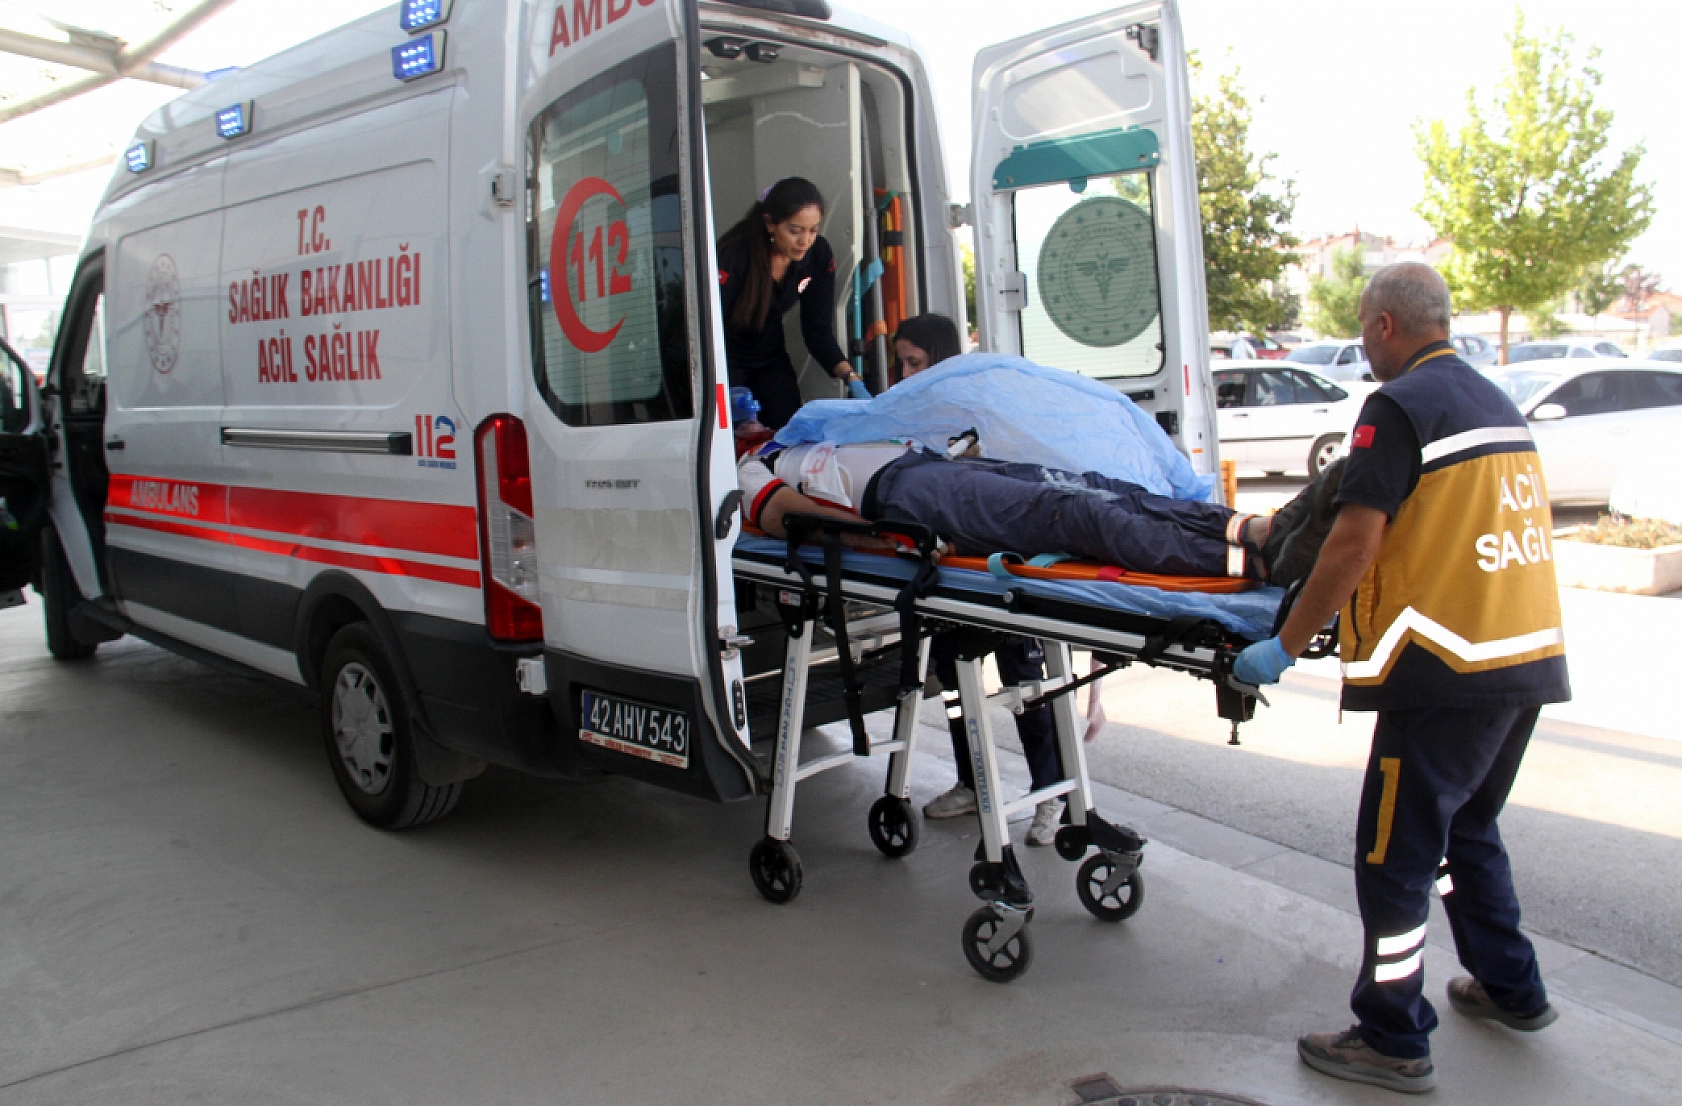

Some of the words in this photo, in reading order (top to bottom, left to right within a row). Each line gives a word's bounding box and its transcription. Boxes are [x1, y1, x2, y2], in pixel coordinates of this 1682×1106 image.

[548, 0, 656, 58] AM
[297, 205, 331, 255] T.C.
[229, 268, 290, 325] SAĞLIK
[301, 242, 421, 317] BAKANLIĞI
[570, 220, 632, 302] 112
[258, 328, 298, 383] ACİL
[304, 322, 382, 382] SAĞLIK
[415, 414, 457, 459] 112
[131, 480, 199, 516] AMBULANS
[1475, 517, 1552, 572] SAĞL
[590, 698, 610, 732] 42
[613, 703, 646, 742] AHV
[649, 711, 685, 752] 543
